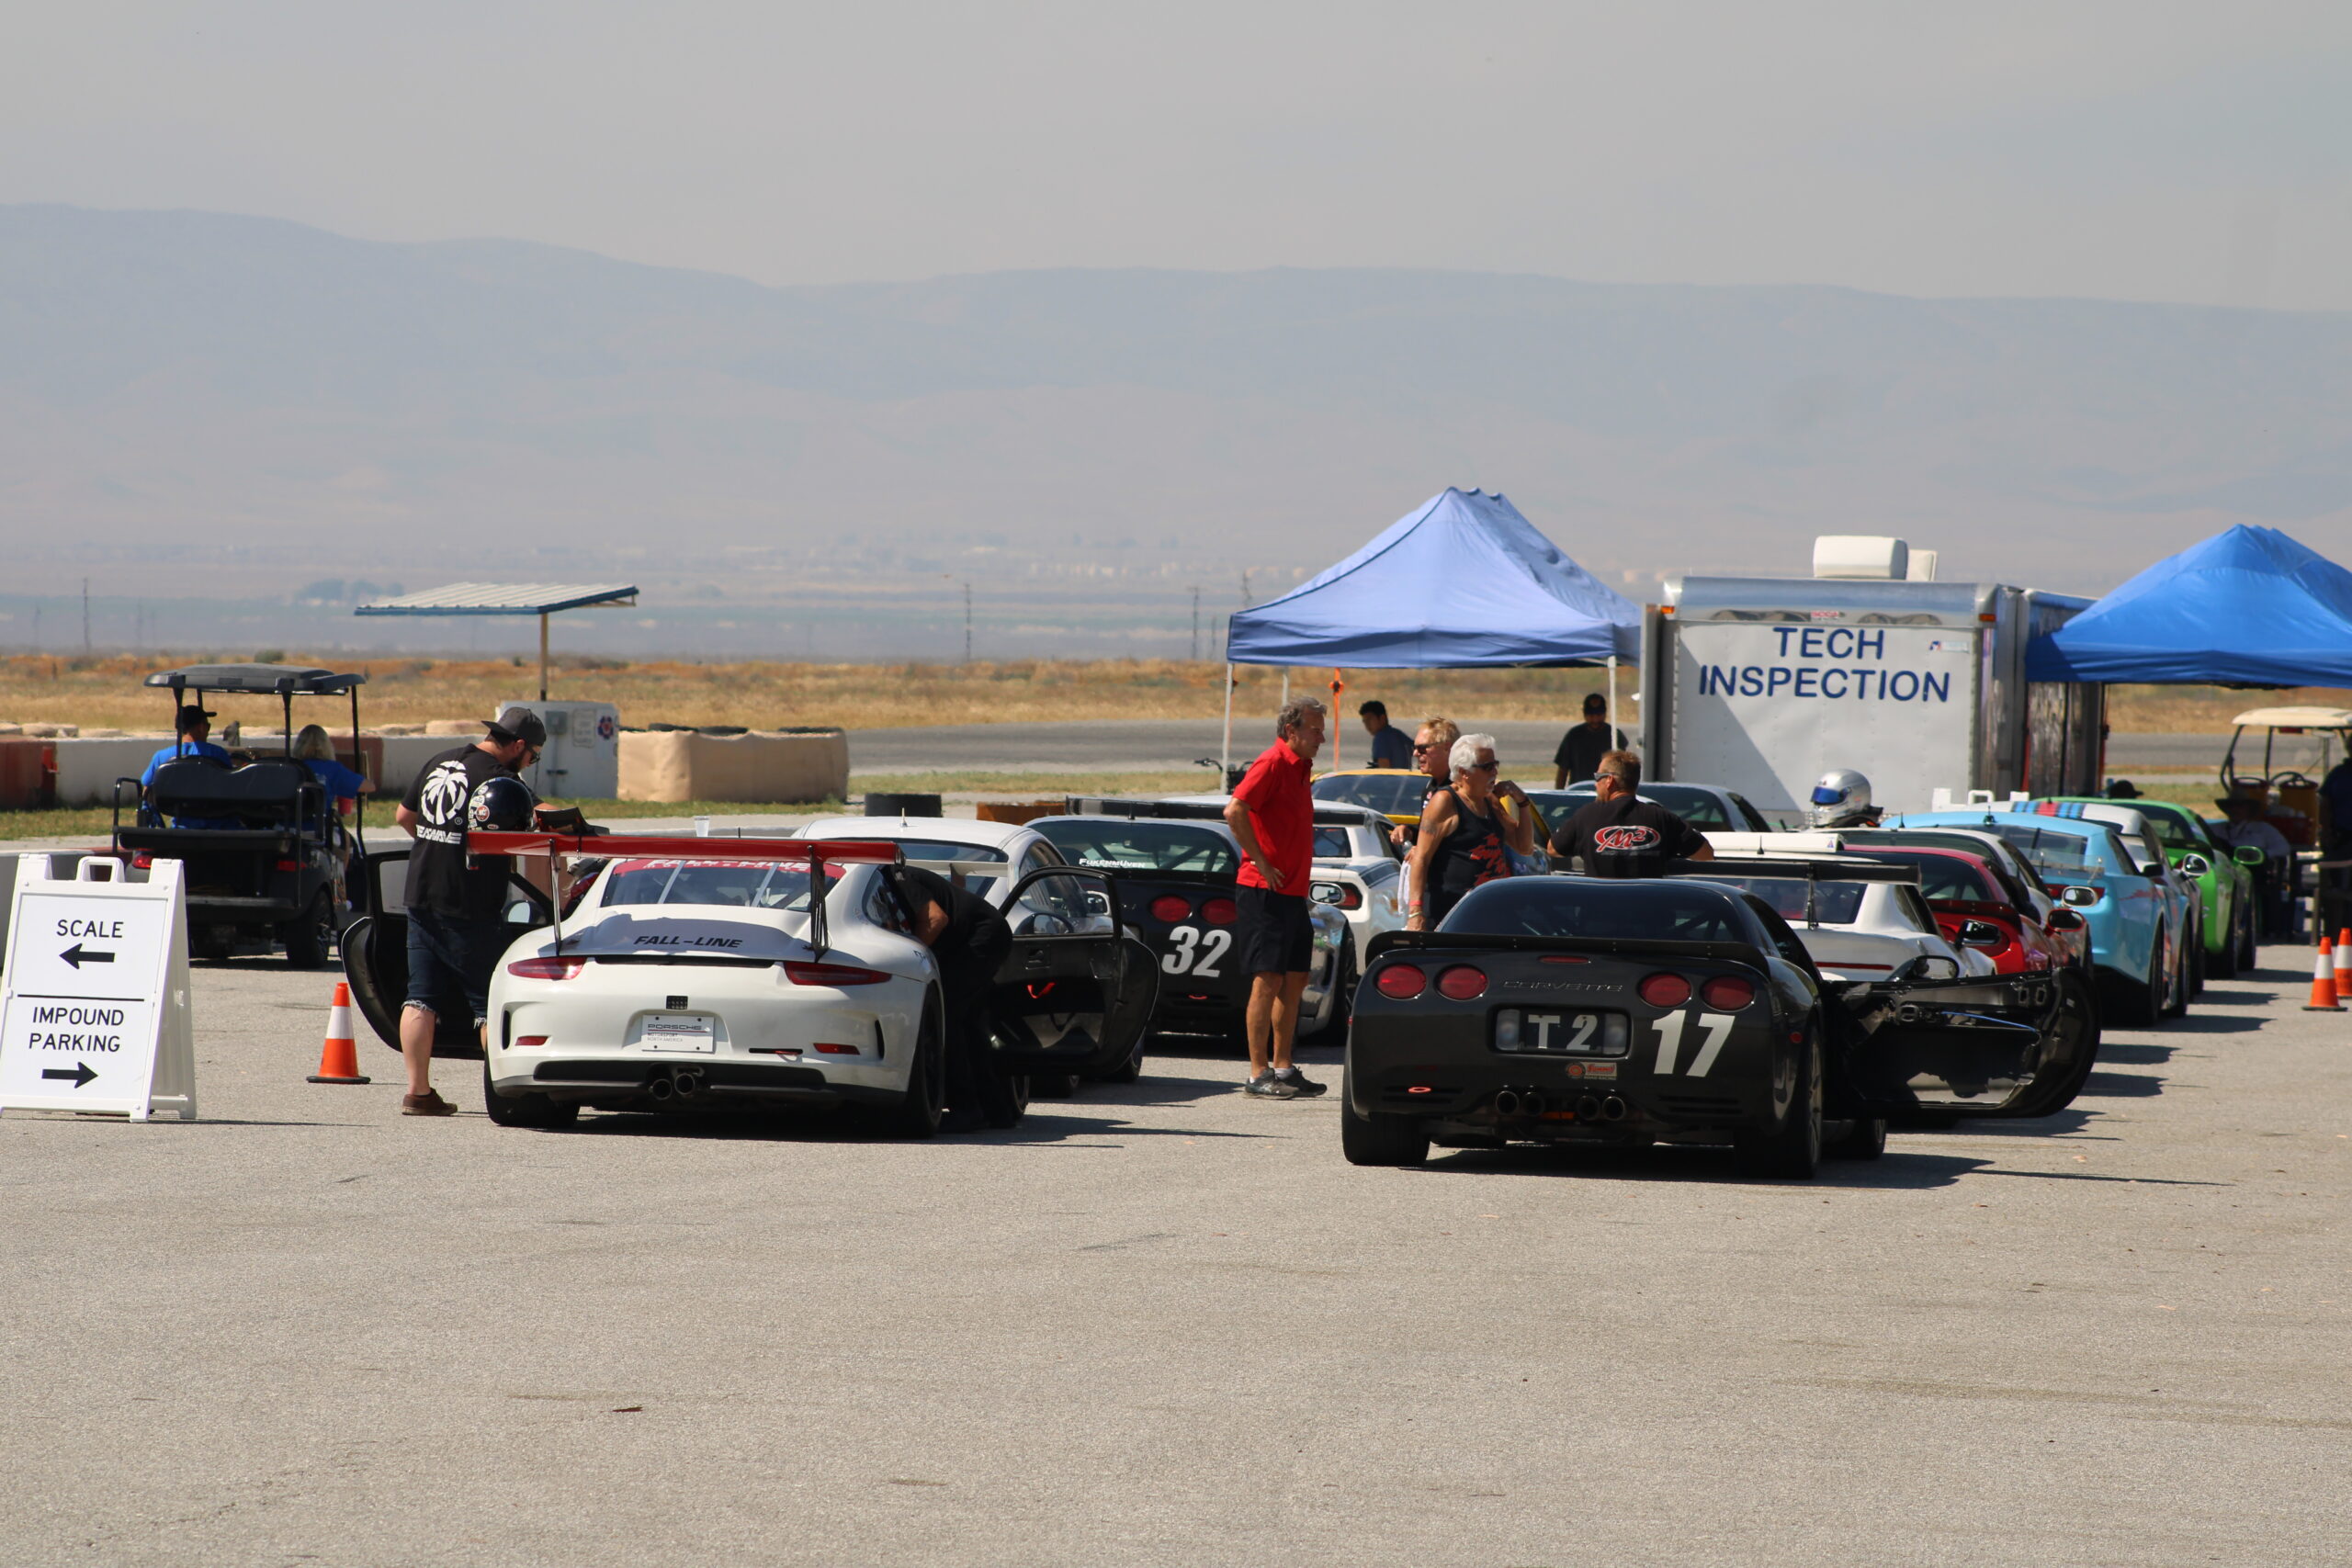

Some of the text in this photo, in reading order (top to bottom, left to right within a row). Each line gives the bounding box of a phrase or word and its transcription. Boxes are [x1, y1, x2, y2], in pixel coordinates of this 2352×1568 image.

[1773, 627, 1884, 660] TECH
[1700, 665, 1950, 702] INSPECTION
[56, 919, 124, 938] SCALE
[634, 935, 743, 948] FALL-LINE
[1161, 925, 1232, 977] 32
[32, 1007, 125, 1026] IMPOUND
[28, 1032, 121, 1053] PARKING
[1652, 1010, 1736, 1077] 17
